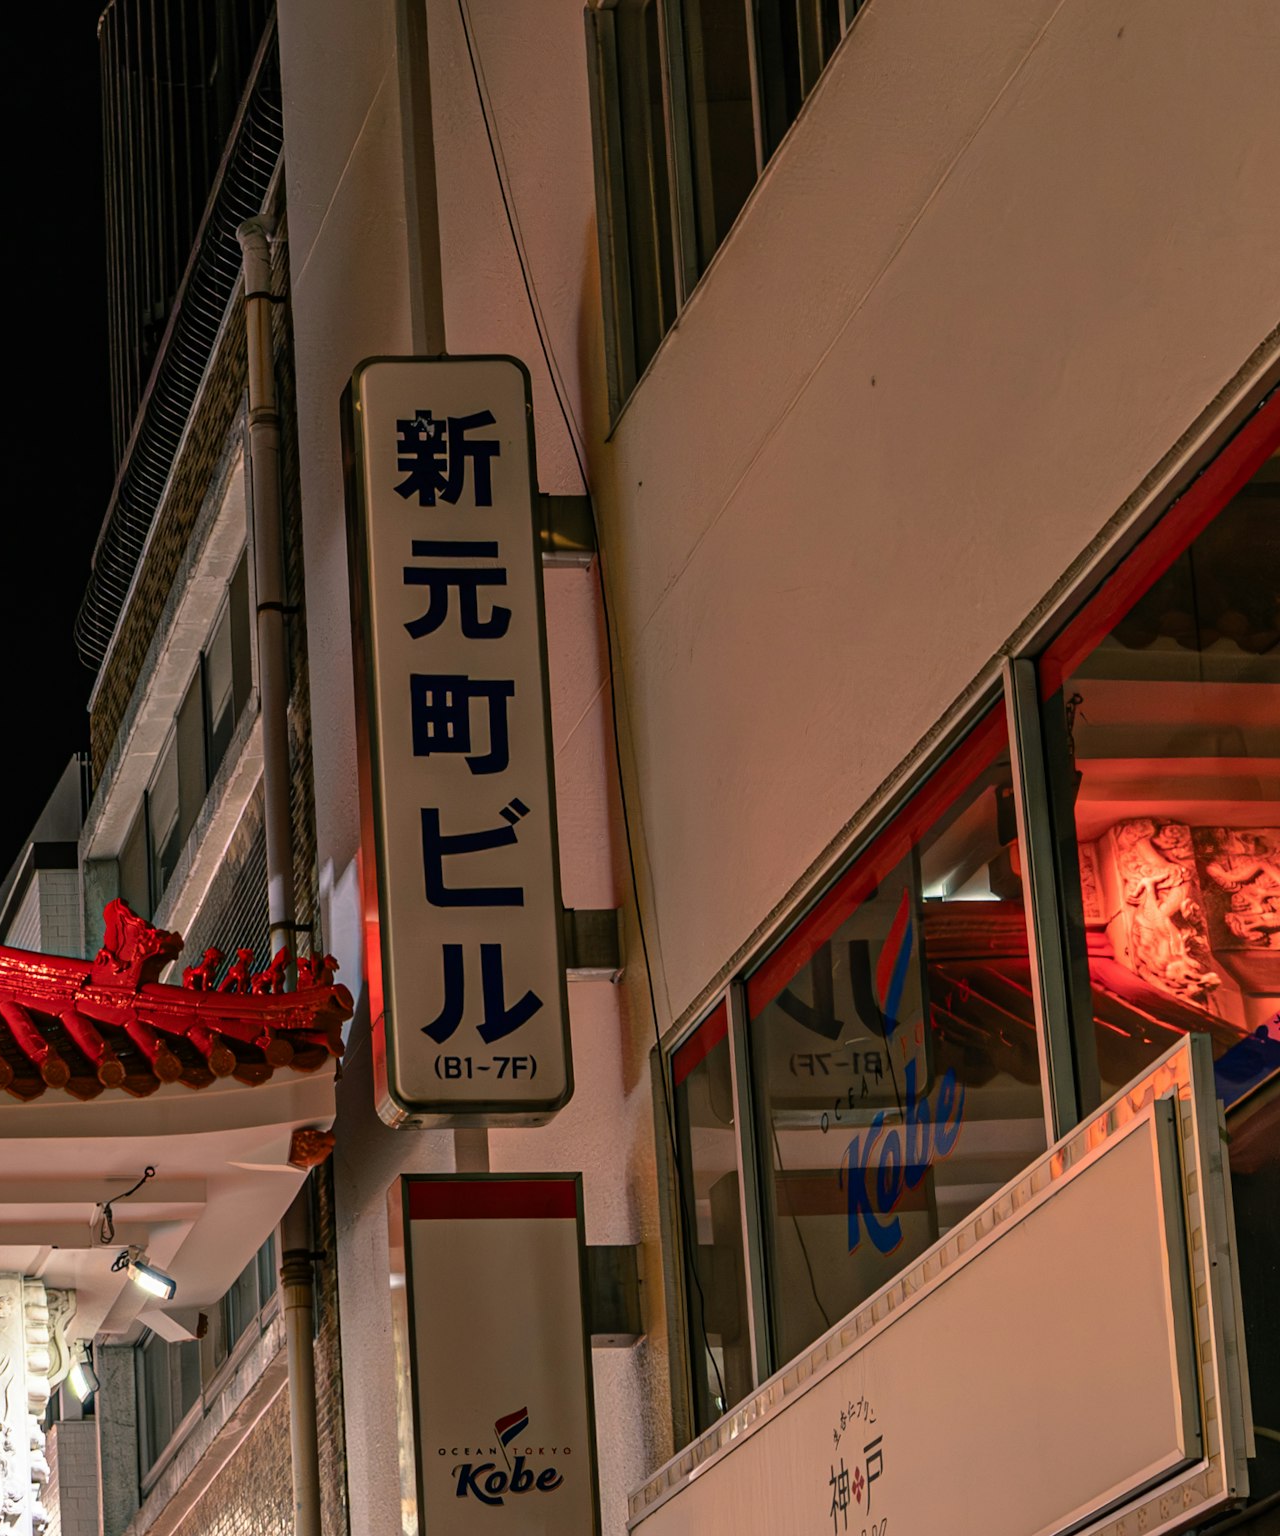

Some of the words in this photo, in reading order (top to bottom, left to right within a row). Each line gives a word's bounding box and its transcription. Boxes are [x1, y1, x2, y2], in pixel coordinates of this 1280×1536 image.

[394, 409, 543, 1044] 新元町ビル
[839, 1056, 967, 1257] Kobe
[438, 1447, 497, 1456] OCEAN
[512, 1446, 572, 1456] TOKYO
[451, 1455, 565, 1506] Kobe
[829, 1434, 884, 1536] 神戸
